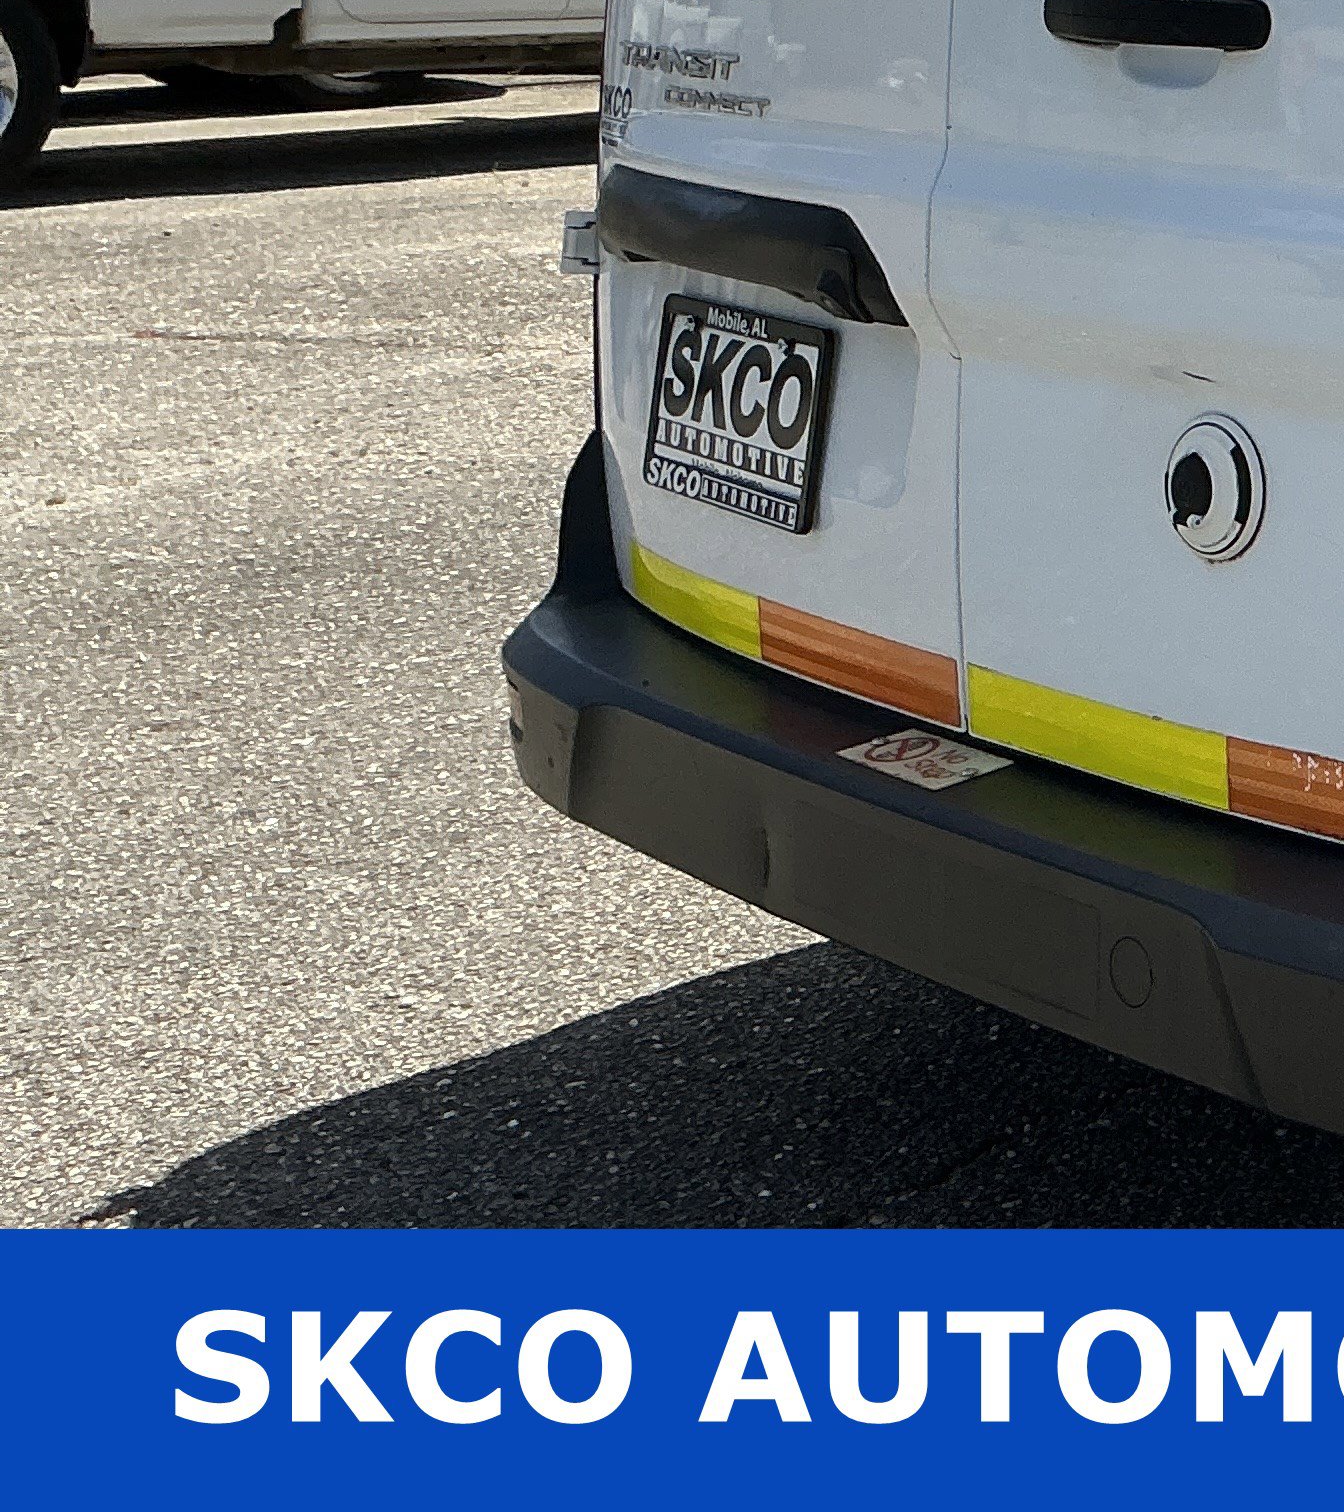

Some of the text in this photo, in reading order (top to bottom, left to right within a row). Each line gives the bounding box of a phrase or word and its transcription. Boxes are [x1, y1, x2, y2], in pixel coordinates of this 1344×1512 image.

[619, 40, 740, 81] TRANSIT
[707, 306, 769, 338] Mobile, AL
[663, 328, 813, 451] SKCO
[656, 418, 807, 487] AUTOMOTIVE
[646, 457, 702, 498] SKCO
[701, 478, 798, 526] AUTOMOTIVE
